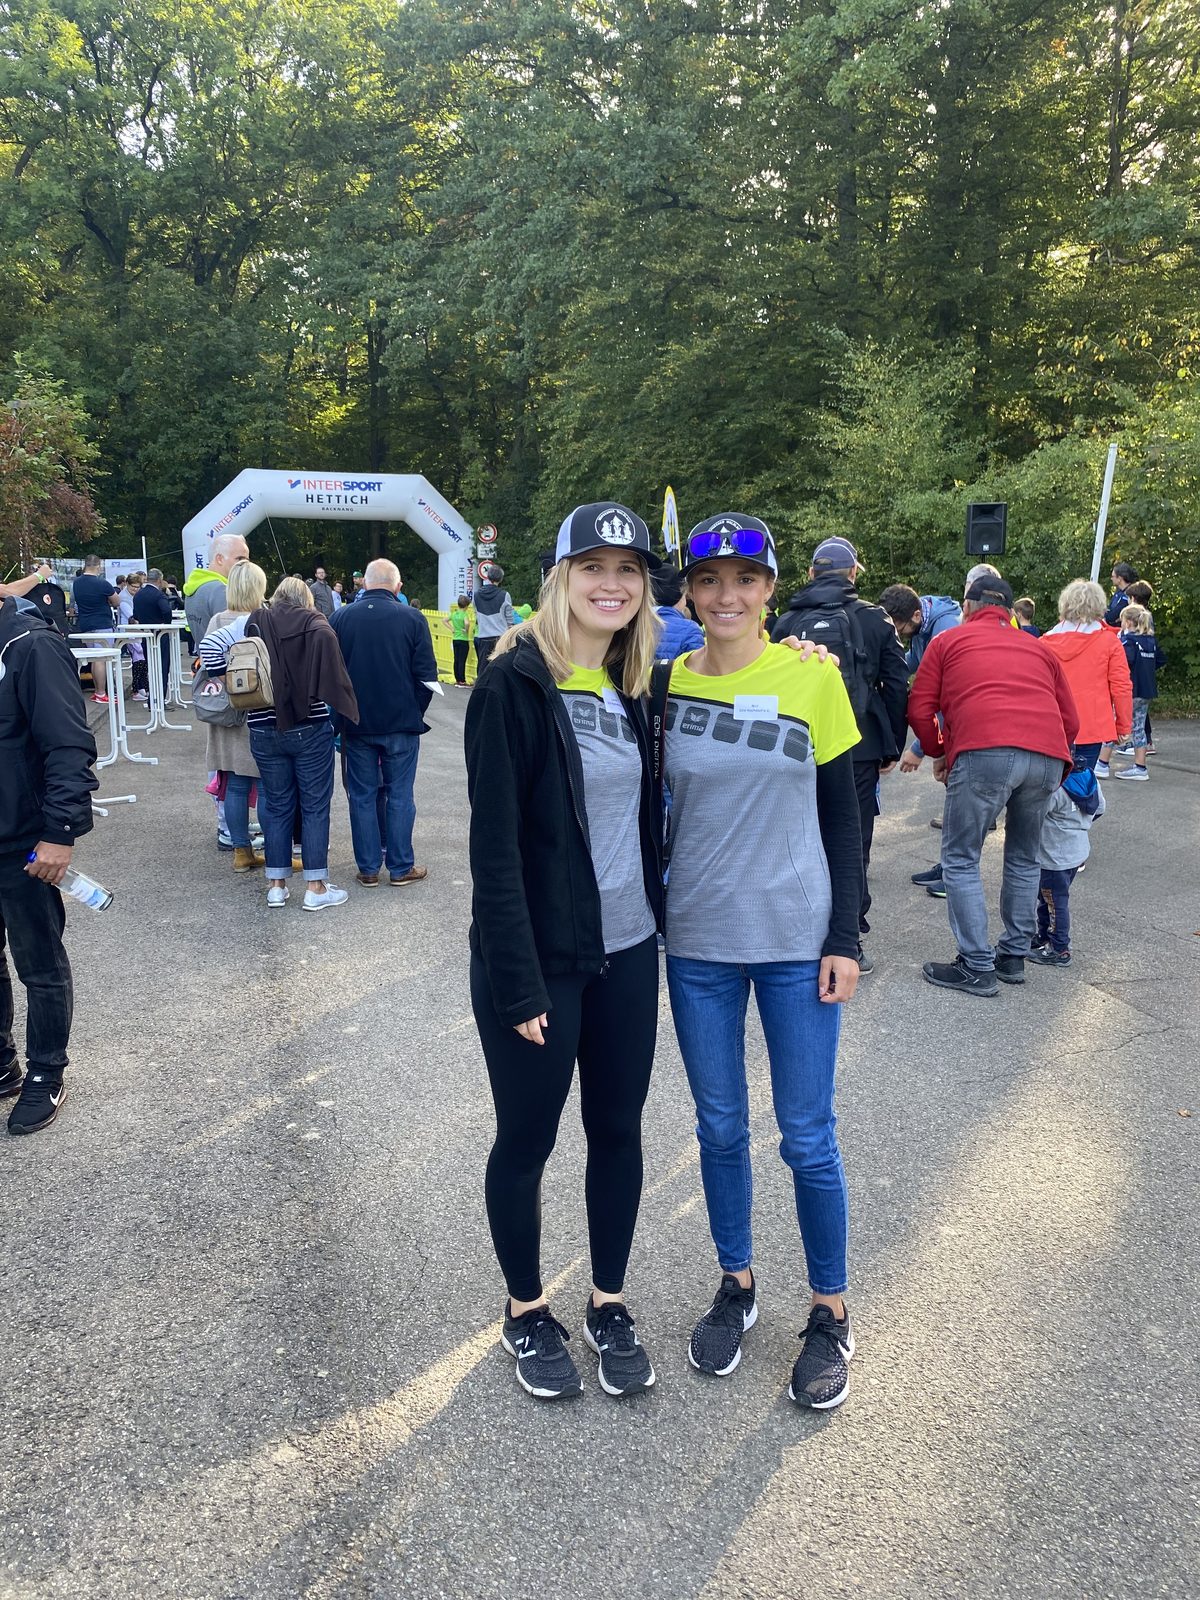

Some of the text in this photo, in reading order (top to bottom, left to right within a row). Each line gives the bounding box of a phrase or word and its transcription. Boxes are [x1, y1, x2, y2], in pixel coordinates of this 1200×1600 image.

[303, 479, 383, 492] INTERSPORT
[305, 494, 369, 505] HETTICH
[213, 494, 254, 533] INTERSPORT
[423, 504, 463, 543] INTERSPORT
[573, 717, 595, 727] erima
[653, 715, 661, 737] EOS
[682, 722, 705, 732] erima
